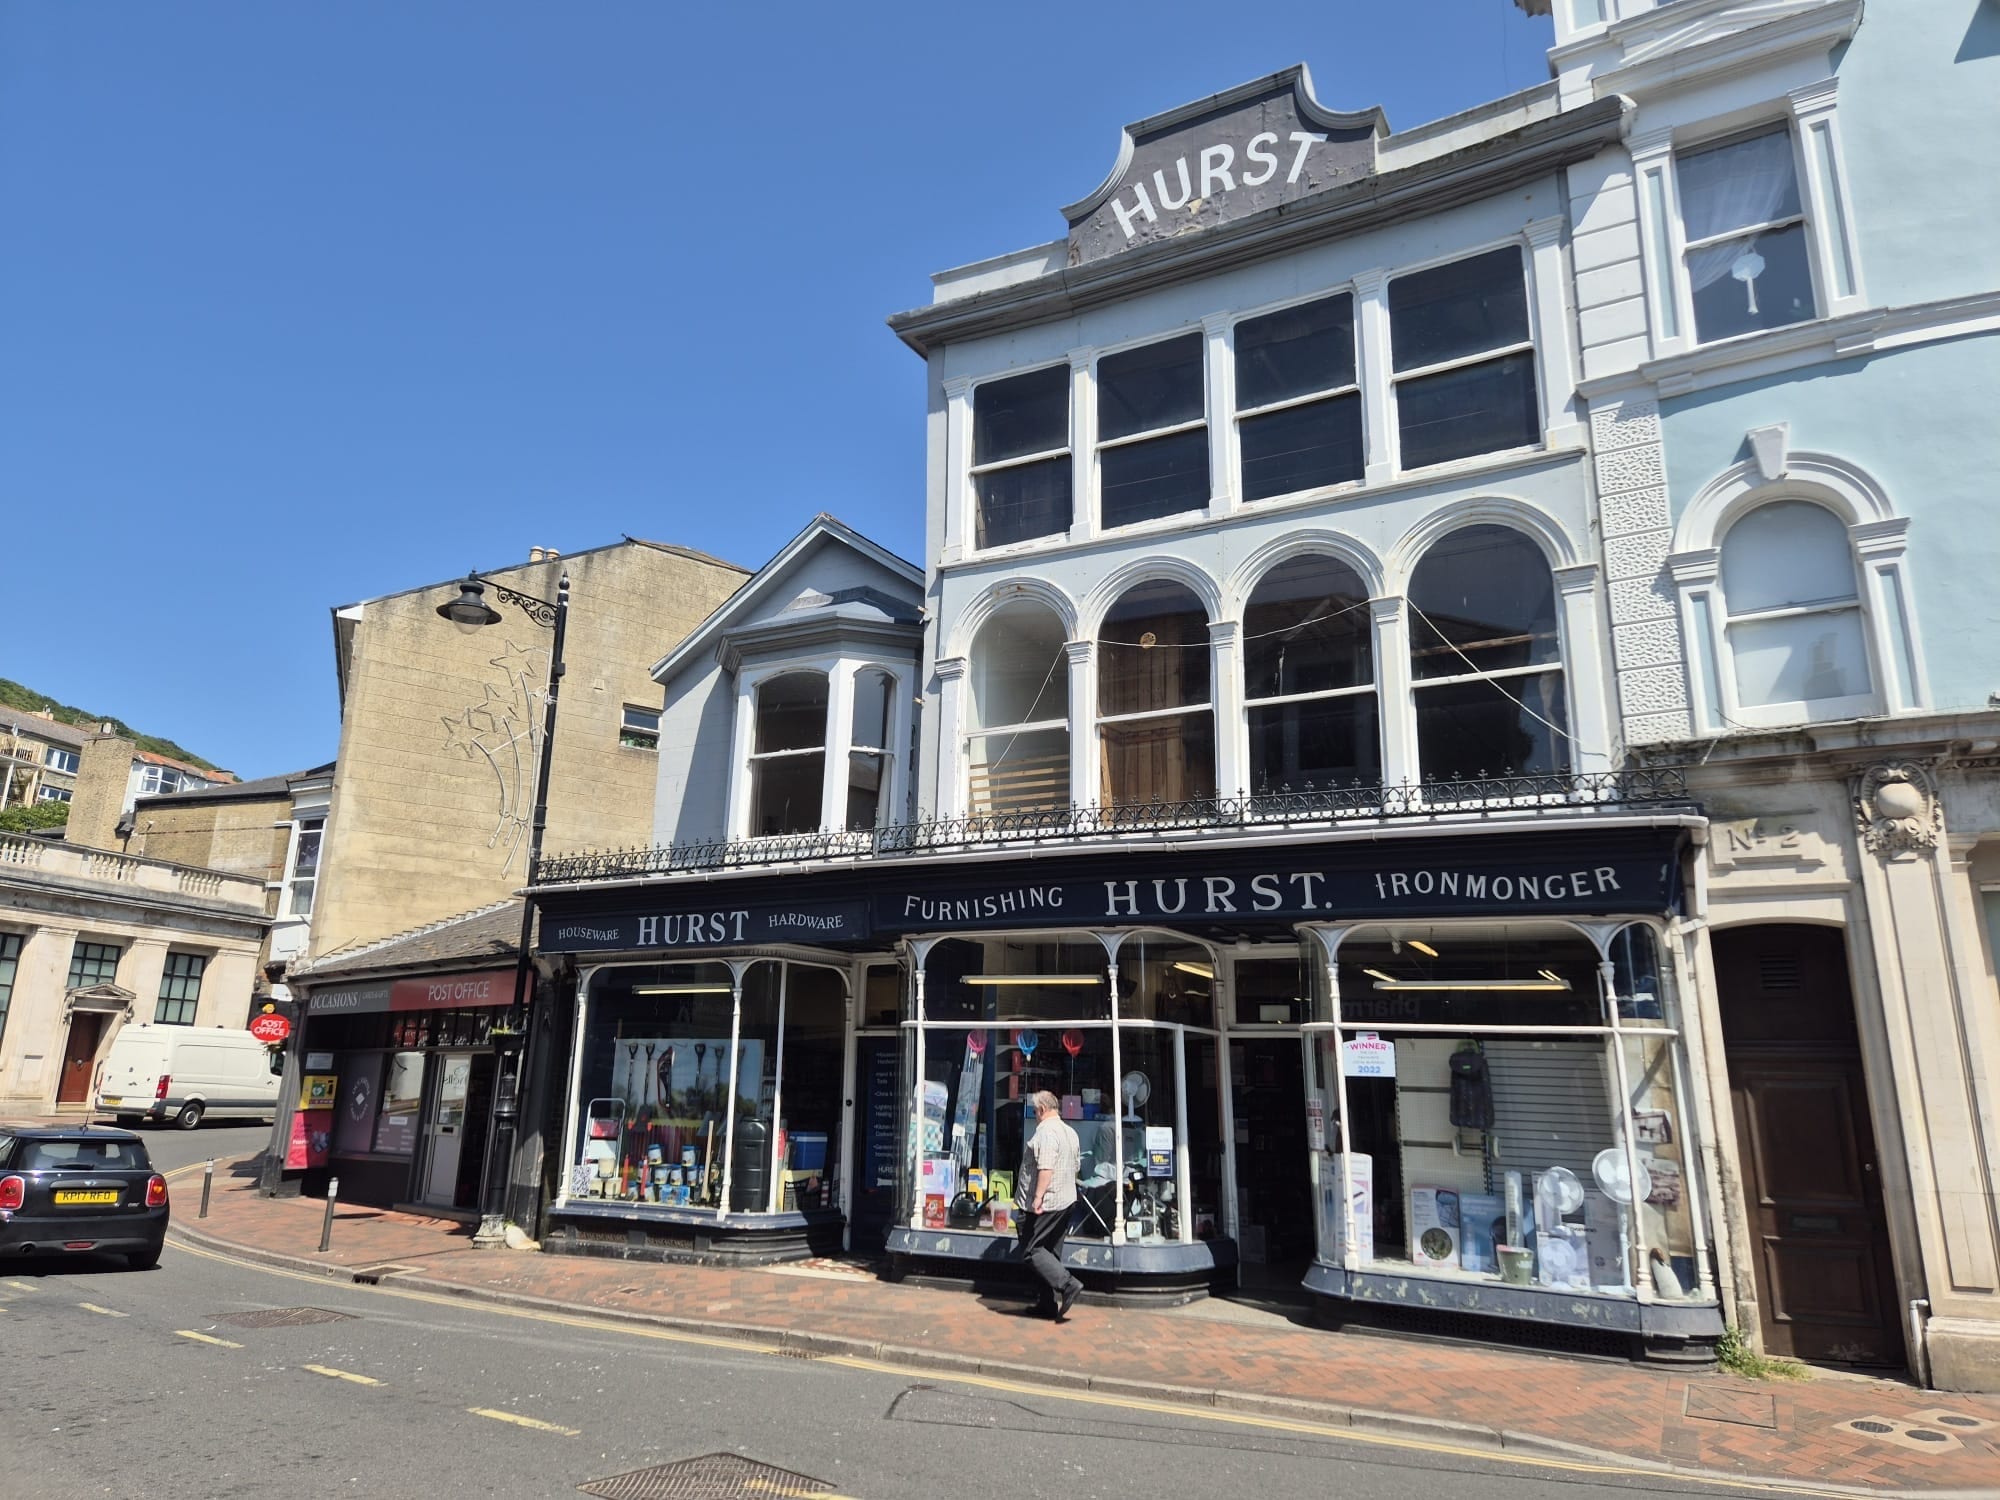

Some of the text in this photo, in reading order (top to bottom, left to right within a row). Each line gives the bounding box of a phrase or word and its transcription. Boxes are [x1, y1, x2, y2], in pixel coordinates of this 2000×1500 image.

[1110, 131, 1329, 239] HURST
[1780, 825, 1800, 848] 2
[903, 866, 1621, 921] FURNISHING HURST. IRONMONGER
[558, 910, 844, 946] HOUSEWARE HURST HARDWARE
[310, 991, 359, 1009] OCCASIONS
[428, 981, 490, 1001] POST OFFICE
[254, 1026, 285, 1036] OFFICE
[261, 1019, 285, 1029] POST
[1350, 1042, 1387, 1051] WINNER
[1358, 1065, 1381, 1073] 2022
